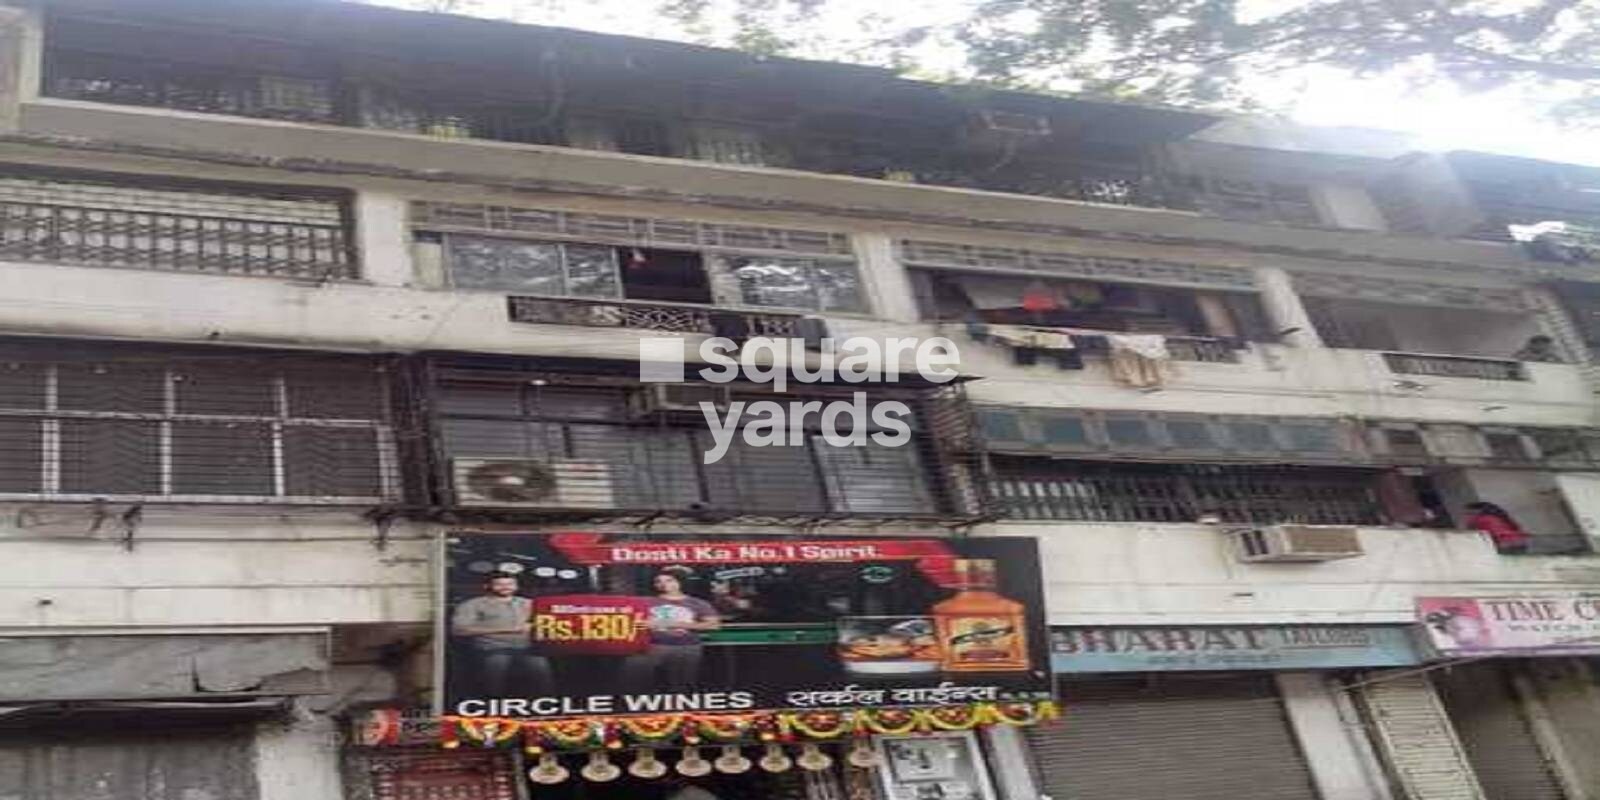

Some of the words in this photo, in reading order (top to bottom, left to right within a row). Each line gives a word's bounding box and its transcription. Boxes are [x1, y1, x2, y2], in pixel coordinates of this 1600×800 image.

[611, 547, 686, 561] Dosti
[695, 547, 731, 560] Ka
[740, 546, 794, 559] No.1
[1483, 600, 1564, 620] TIME
[1052, 628, 1267, 653] BHARAT
[457, 695, 614, 717] CIRCLE
[625, 691, 754, 712] WINES
[787, 684, 886, 706] सर्कल
[890, 682, 999, 704] वाईन्स
